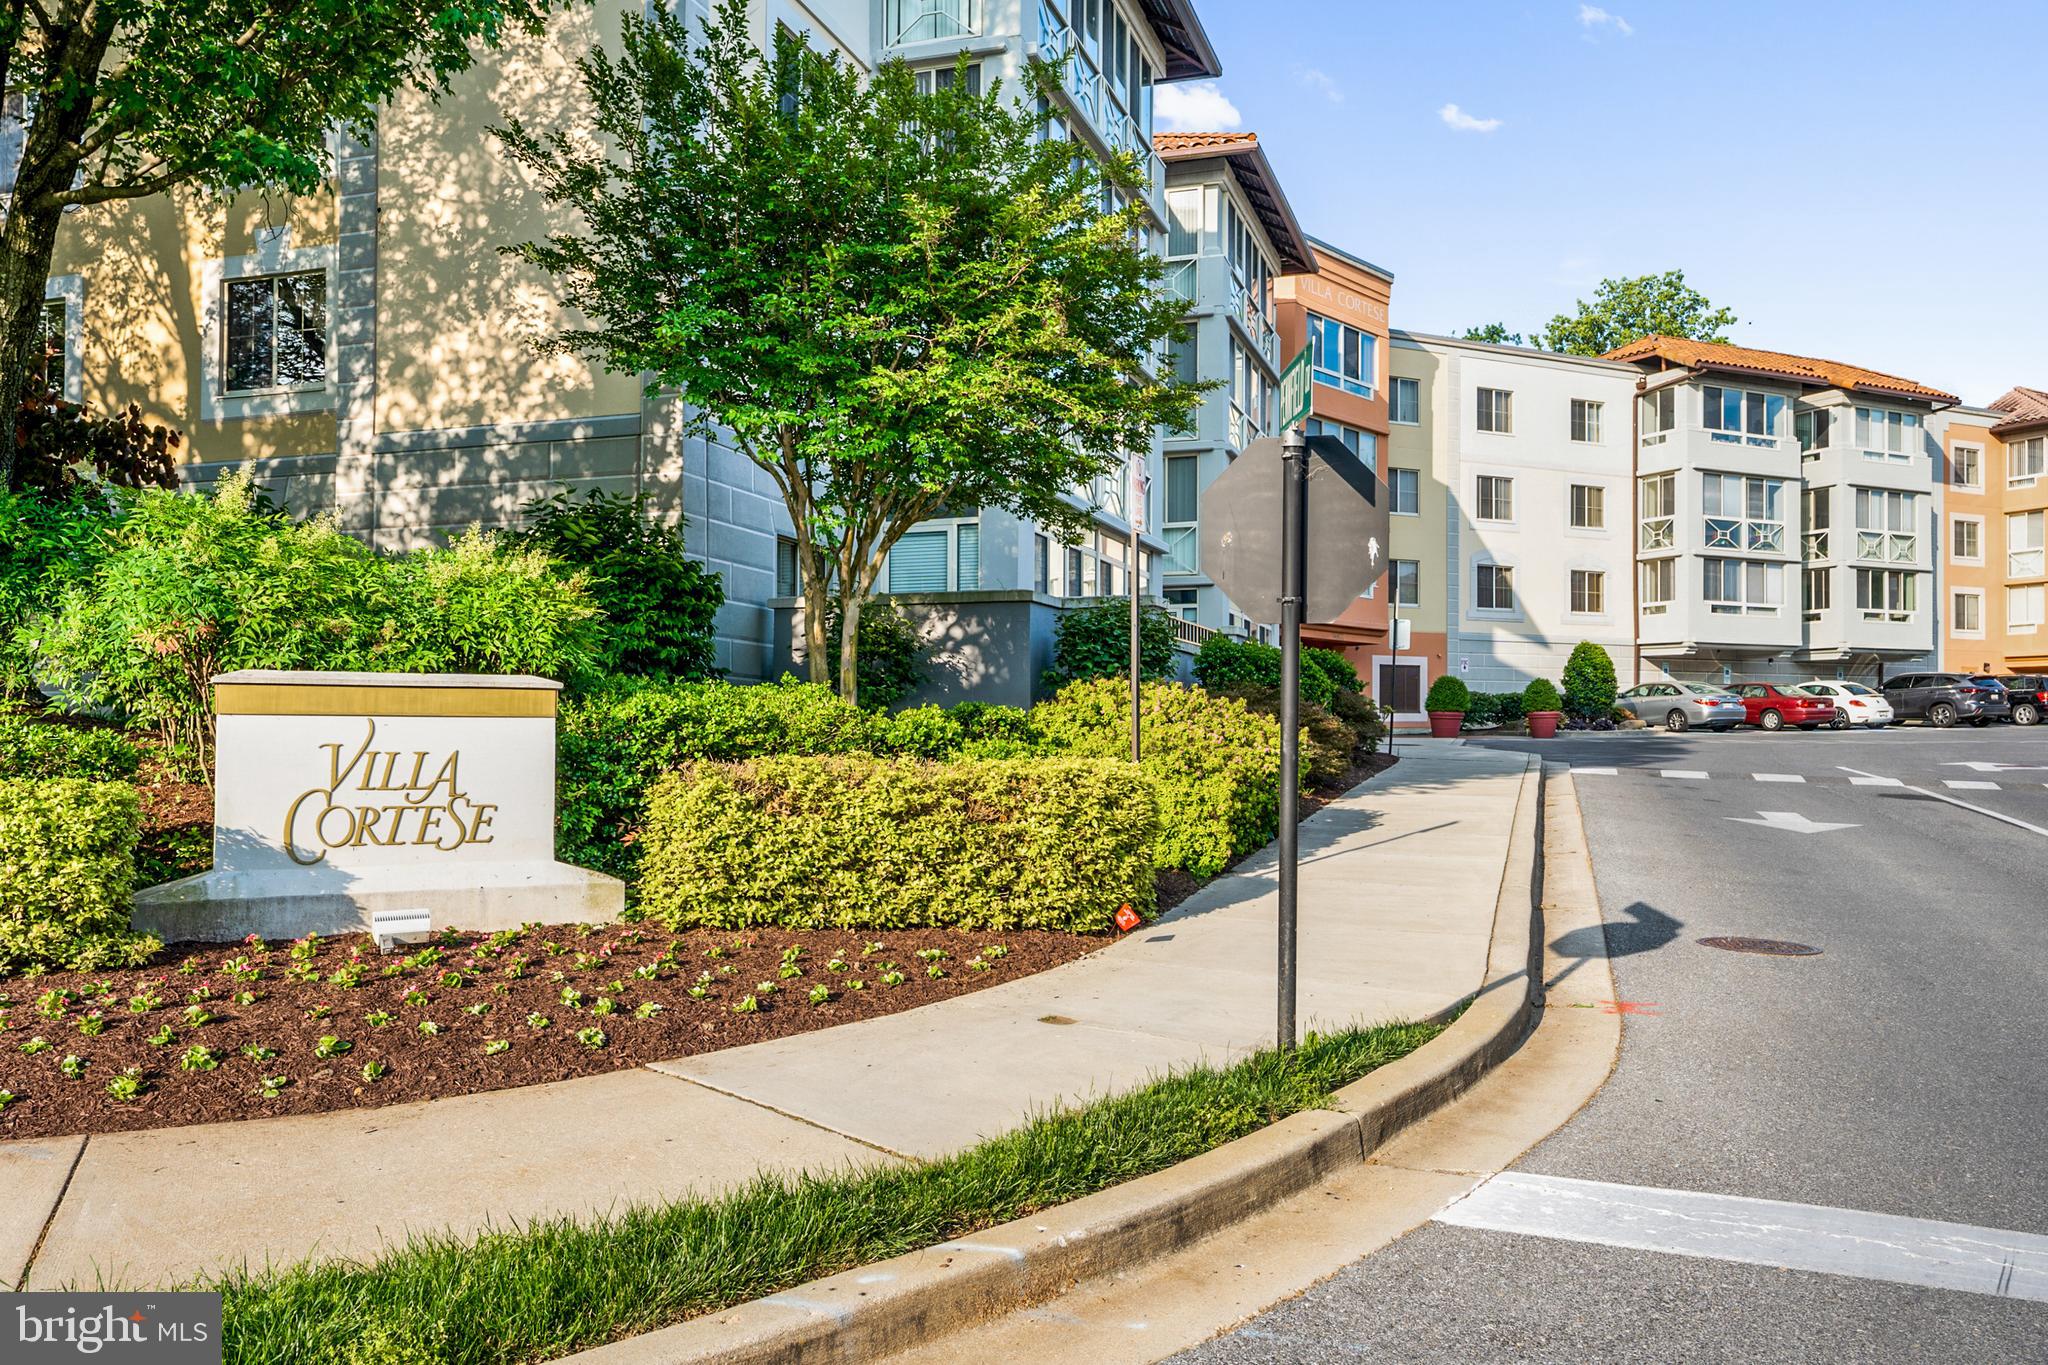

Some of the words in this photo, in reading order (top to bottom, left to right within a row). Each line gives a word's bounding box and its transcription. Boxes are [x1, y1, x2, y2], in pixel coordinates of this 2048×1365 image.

[1300, 277, 1333, 302] VILLA
[1337, 290, 1385, 323] CORTESE
[318, 718, 468, 804] VILLA
[283, 788, 498, 865] CORTESE
